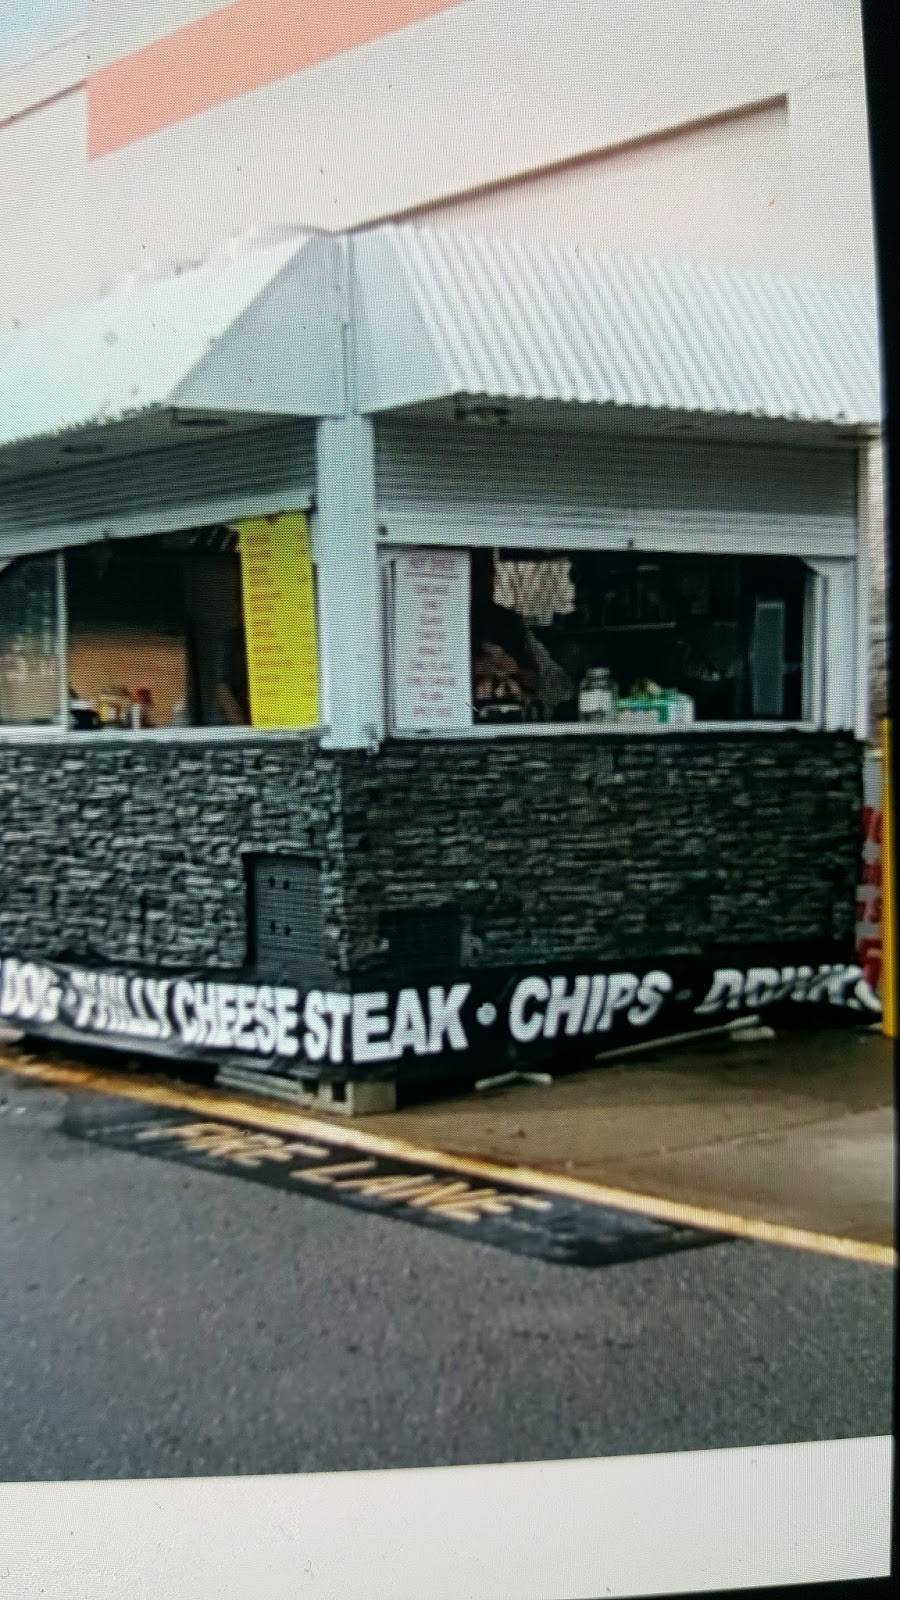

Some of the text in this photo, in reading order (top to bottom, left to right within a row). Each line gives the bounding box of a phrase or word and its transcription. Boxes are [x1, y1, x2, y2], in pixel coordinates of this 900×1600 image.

[1, 957, 62, 1022] DOG
[172, 980, 299, 1056] CHEESE
[303, 984, 471, 1064] STEAK
[509, 970, 673, 1042] CHIPS
[289, 1159, 552, 1224] LANE
